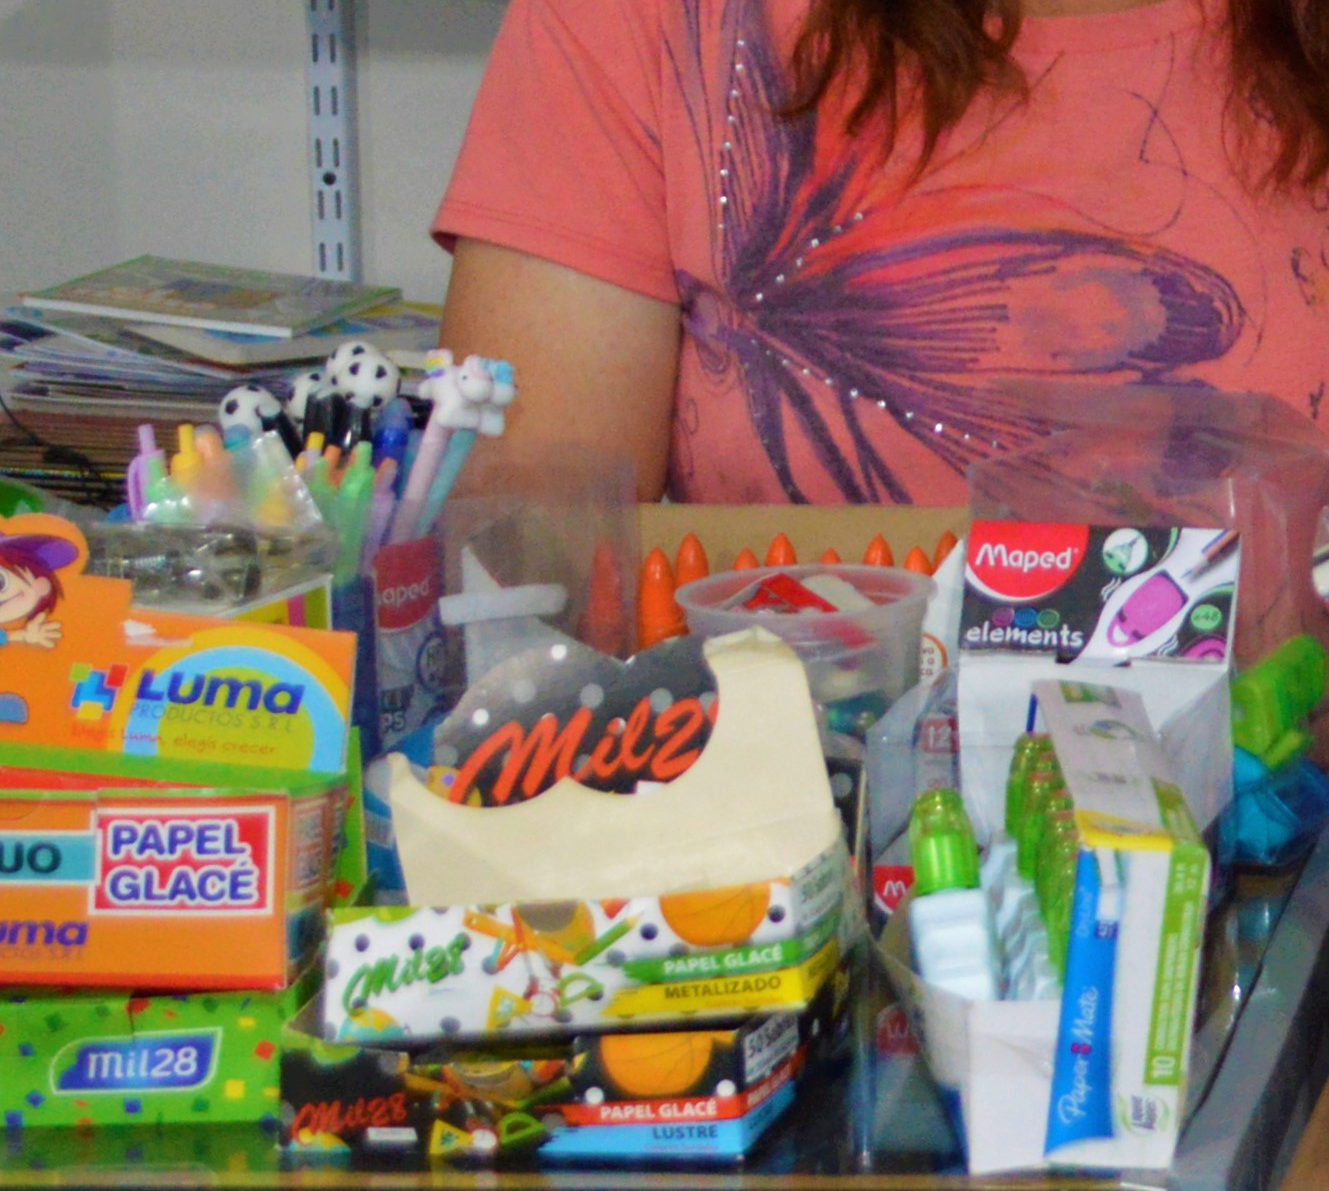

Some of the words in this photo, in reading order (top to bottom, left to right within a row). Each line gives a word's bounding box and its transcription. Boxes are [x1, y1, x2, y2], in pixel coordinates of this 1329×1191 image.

[976, 543, 1072, 572] Maped
[378, 579, 431, 605] aped
[966, 621, 1083, 648] elements
[137, 669, 304, 715] Luma
[132, 703, 243, 732] PRODUCTOS
[222, 740, 276, 756] crecer
[449, 697, 720, 804] Mil2
[927, 724, 952, 748] 12
[111, 824, 247, 857] PAPEL
[109, 861, 256, 903] GLACÉ
[664, 958, 719, 976] PAPEL
[723, 945, 784, 968] GLACÉ
[664, 975, 783, 1000] METALIZADO
[1071, 986, 1098, 1041] Mate
[87, 1046, 199, 1080] mil28
[1153, 1055, 1176, 1078] 10
[1058, 1057, 1091, 1125] Paper
[601, 1101, 655, 1120] PAPEL
[658, 1098, 718, 1117] GLACÉ
[652, 1124, 720, 1141] LUSTRE
